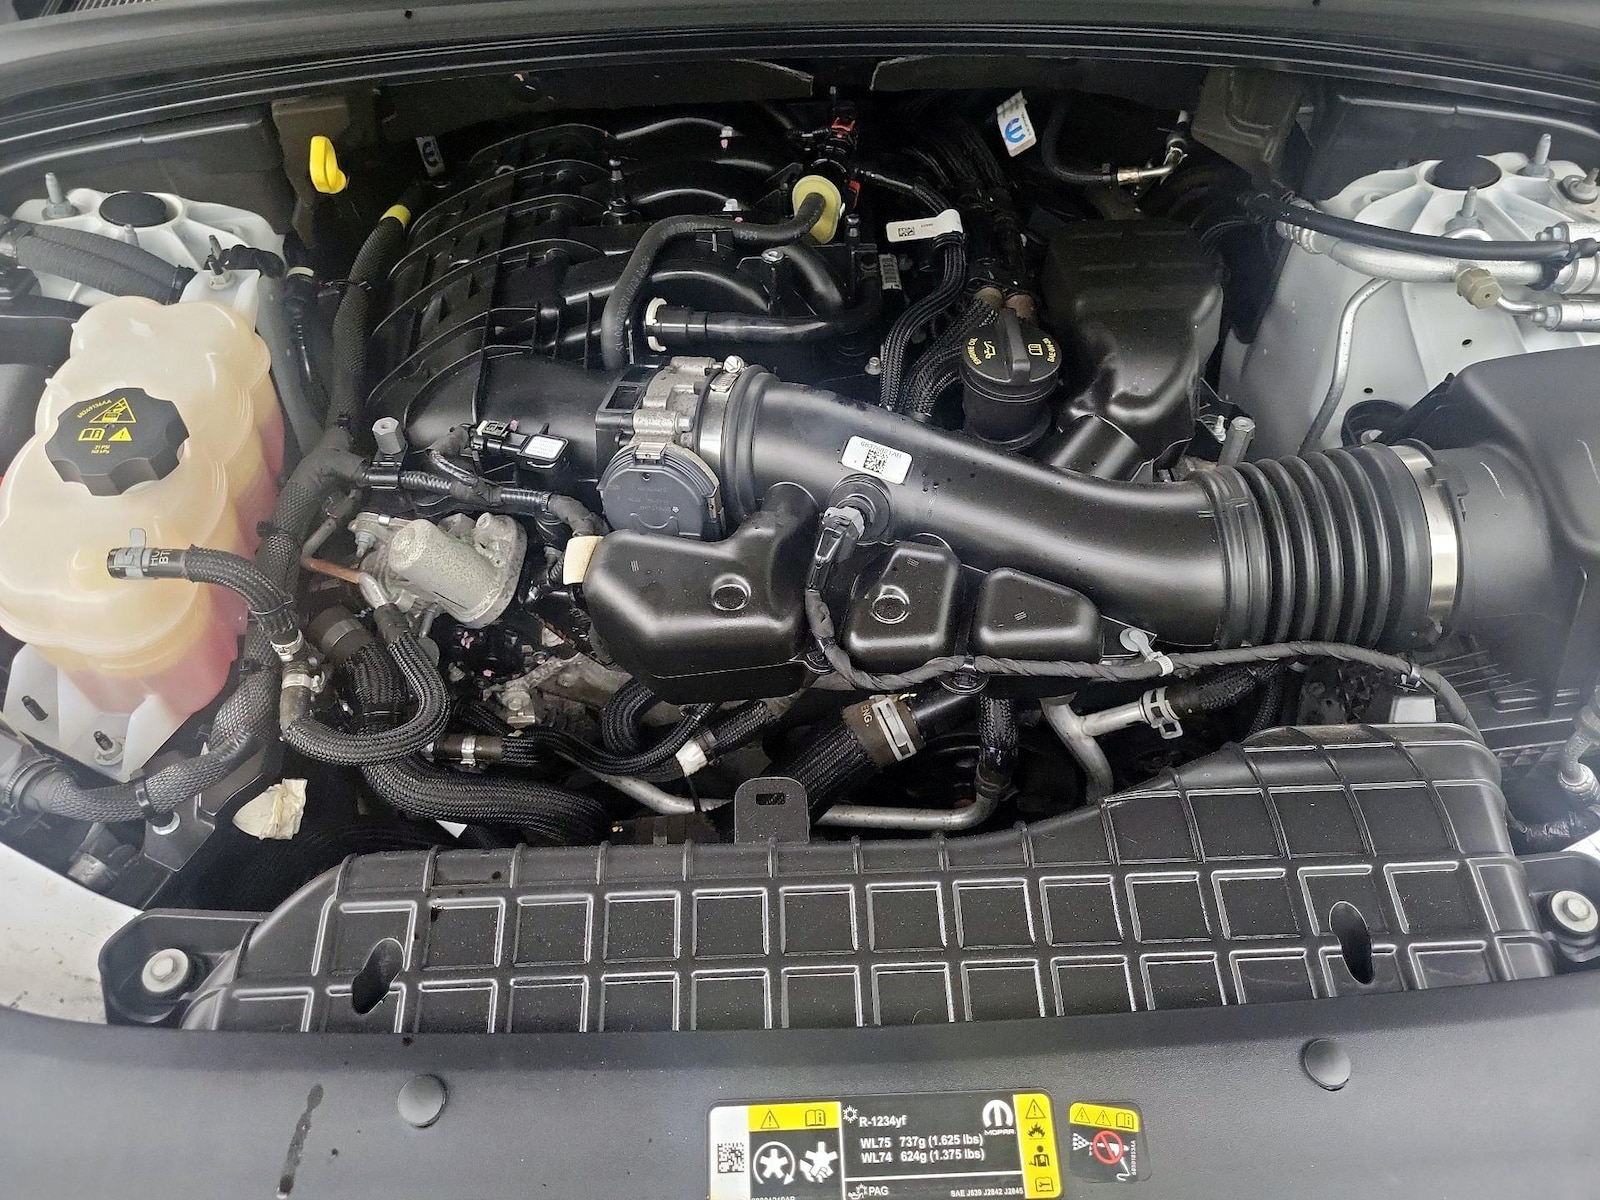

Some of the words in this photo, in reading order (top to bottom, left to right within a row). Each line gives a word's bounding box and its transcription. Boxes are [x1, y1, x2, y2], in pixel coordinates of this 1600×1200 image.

[859, 1114, 908, 1129] R-1234yf
[860, 1137, 892, 1149] WL75
[899, 1135, 926, 1149] 737g
[928, 1134, 961, 1148] (1.625
[962, 1132, 984, 1147] lbs)
[861, 1151, 893, 1164] WL74
[900, 1150, 927, 1164] 624g
[929, 1149, 962, 1163] (1.375
[964, 1147, 985, 1161] lbs)
[868, 1186, 889, 1196] PAG
